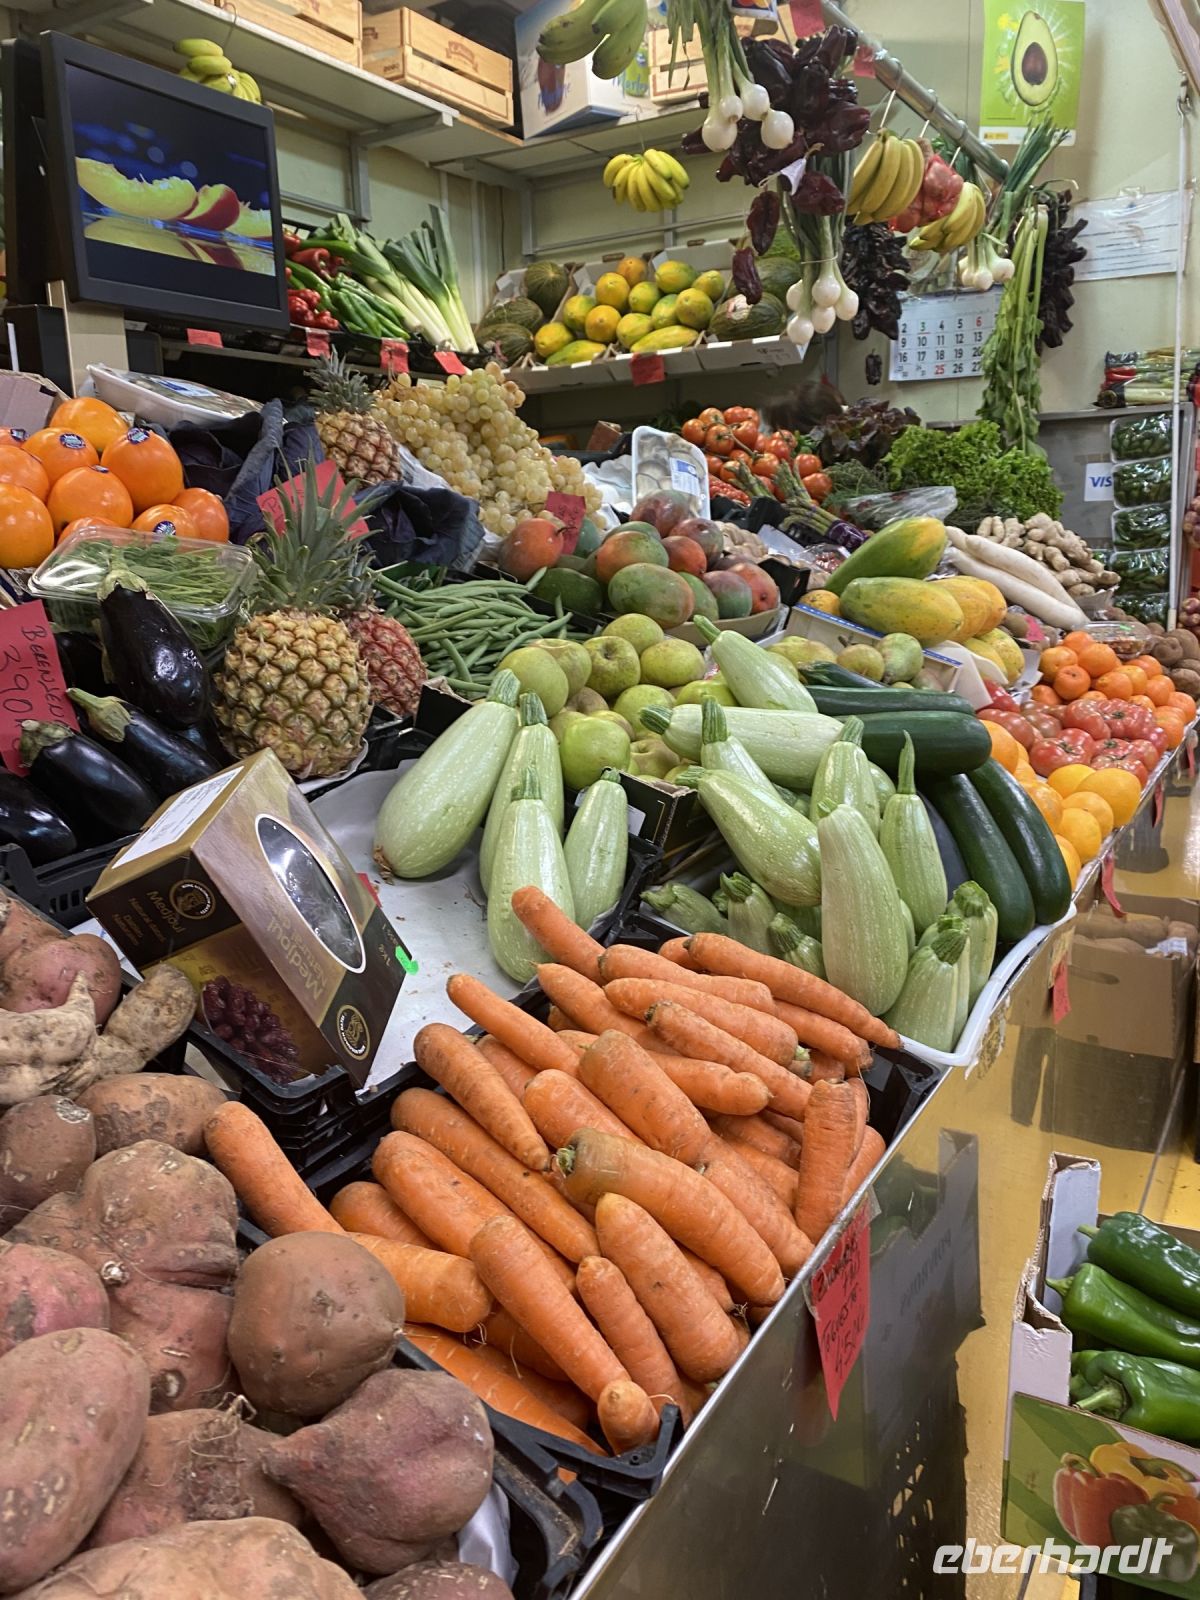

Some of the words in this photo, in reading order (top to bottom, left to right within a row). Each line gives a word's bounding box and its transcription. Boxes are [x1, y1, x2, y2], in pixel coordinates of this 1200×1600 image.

[902, 323, 907, 333] 2
[920, 322, 926, 331] 3
[939, 320, 944, 330] 4
[958, 319, 963, 328] 5
[976, 316, 982, 327] 6
[901, 337, 907, 347] 9
[917, 336, 927, 346] 10
[937, 335, 945, 345] 11
[956, 334, 964, 344] 12
[974, 331, 983, 342] 13
[899, 352, 908, 362] 16
[917, 351, 926, 361] 17
[936, 350, 945, 360] 18
[954, 348, 964, 358] 19
[934, 365, 945, 374] 25
[953, 363, 963, 373] 26
[1088, 476, 1113, 488] VIS
[266, 917, 324, 999] Medjoul
